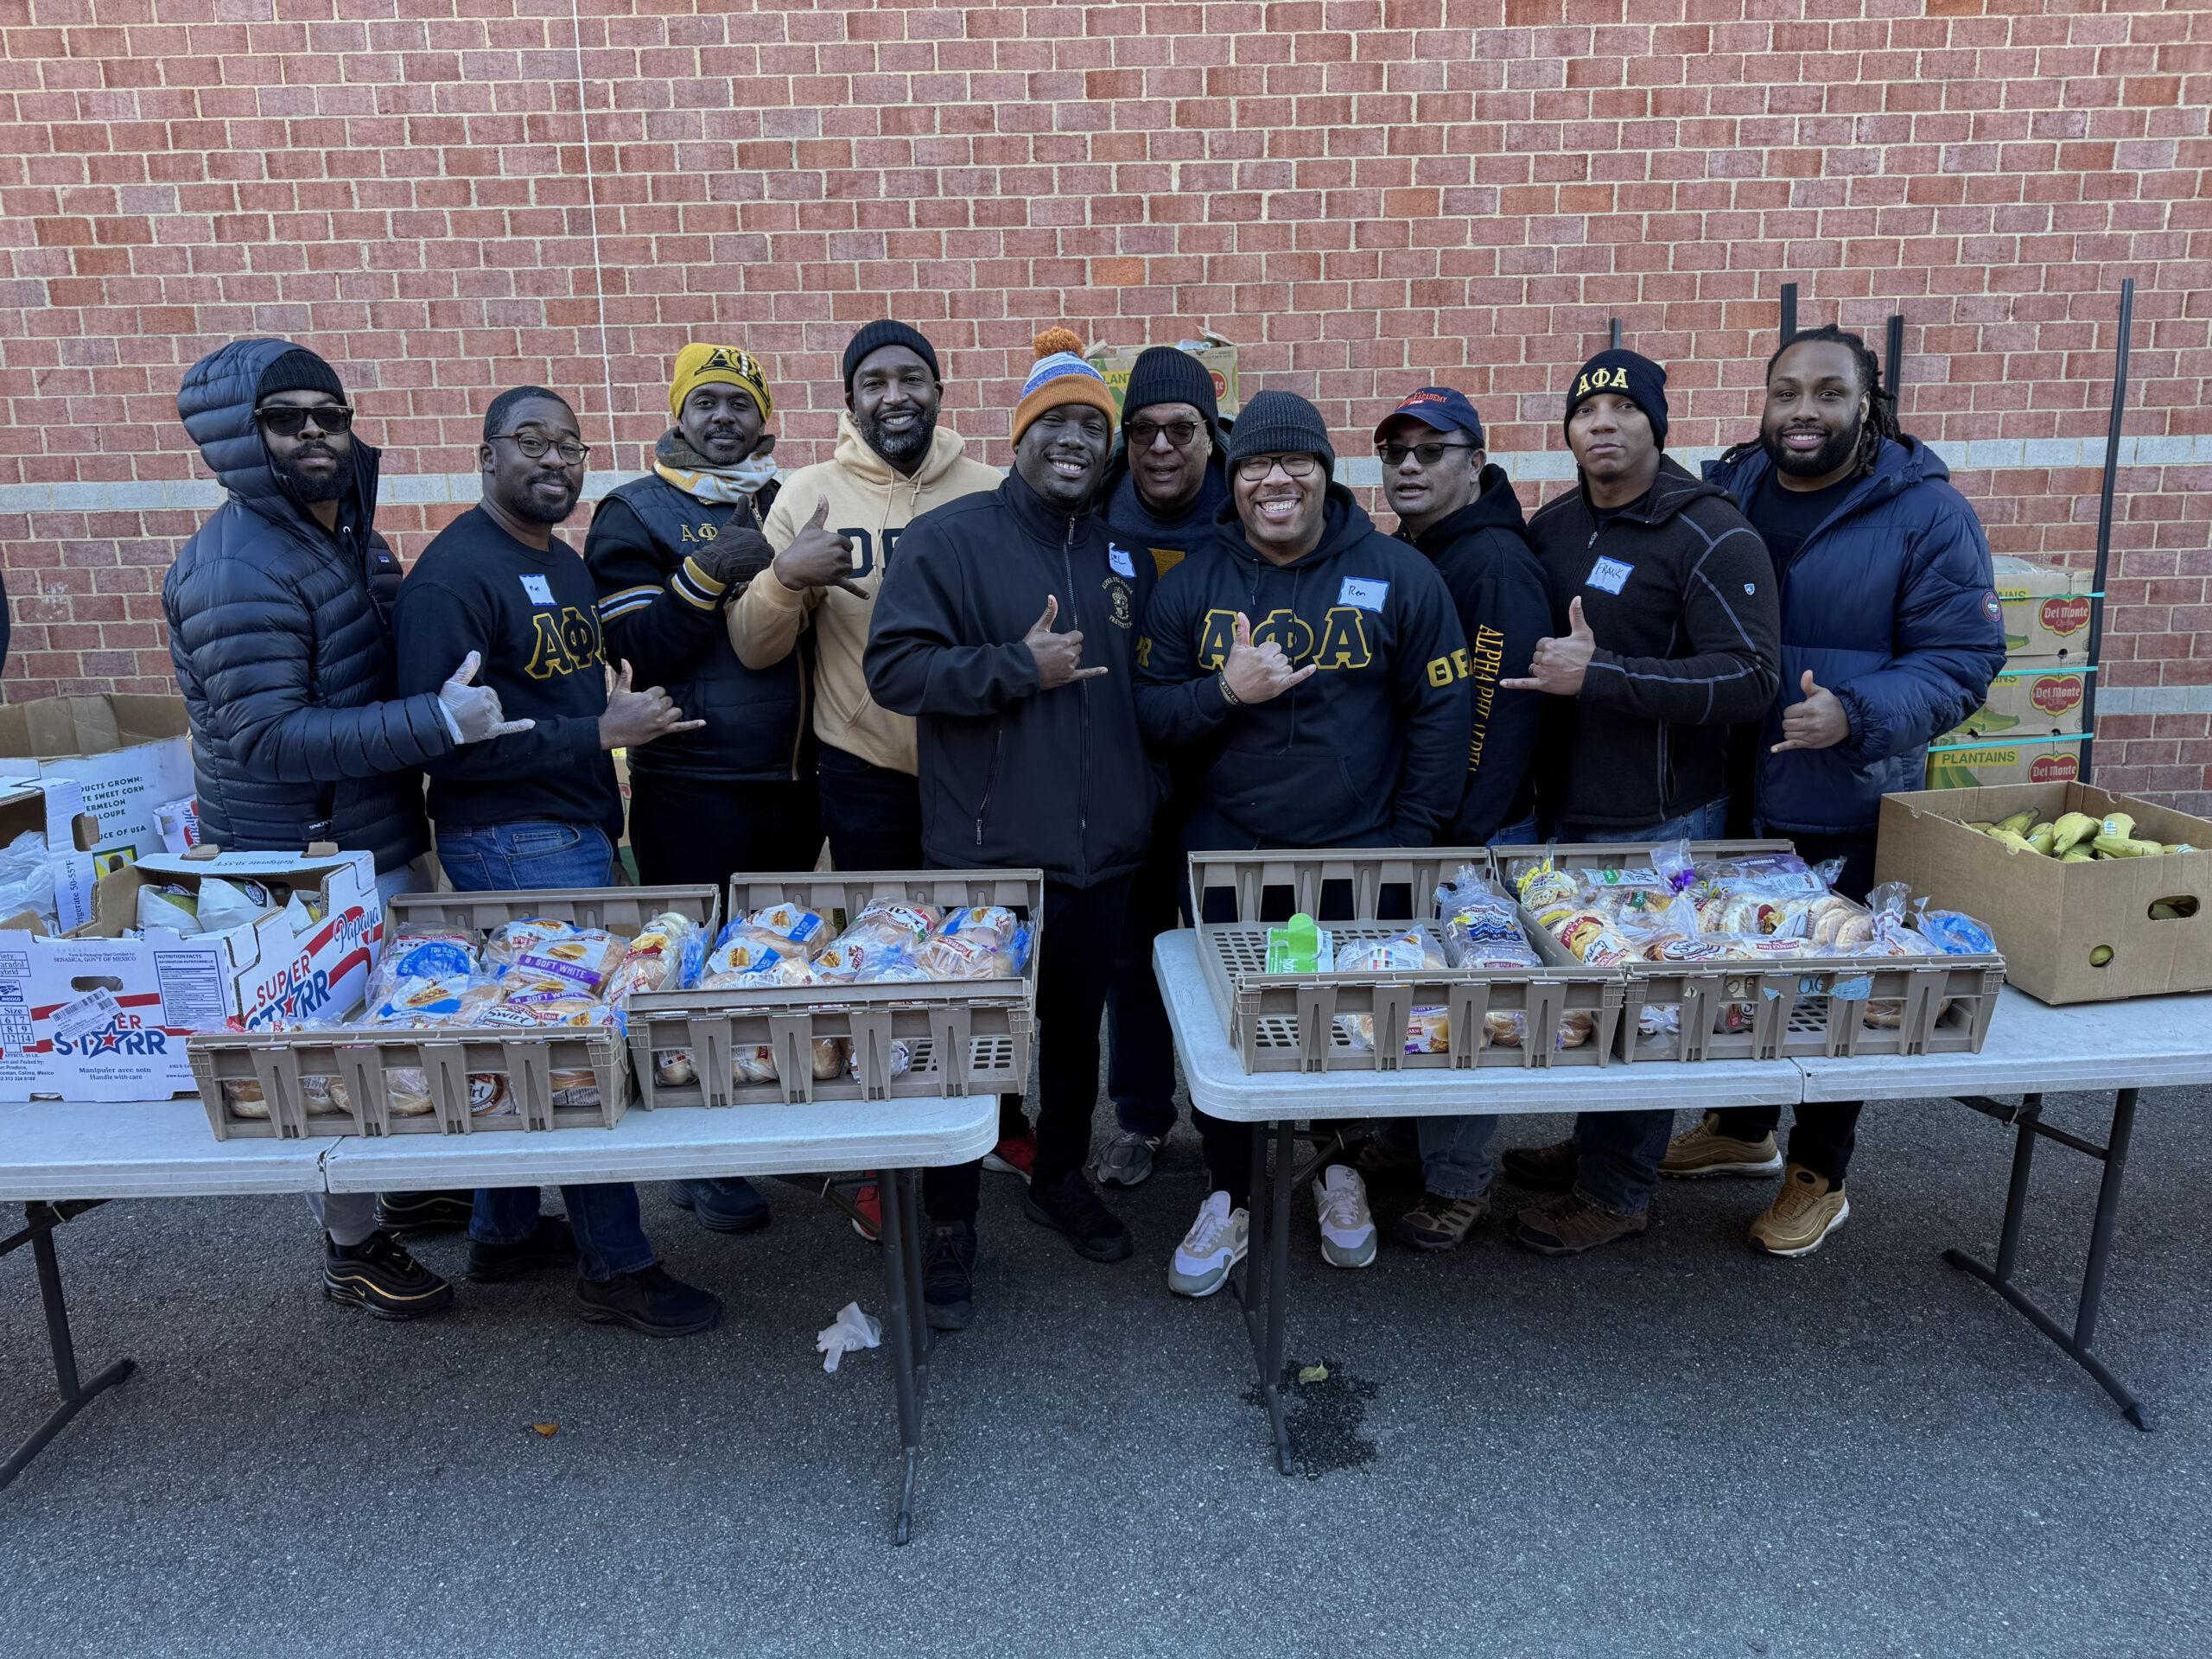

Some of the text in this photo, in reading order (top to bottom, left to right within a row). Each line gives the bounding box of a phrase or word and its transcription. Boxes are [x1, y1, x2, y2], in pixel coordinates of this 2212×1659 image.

[1576, 367, 1629, 397] ΑΦΑ
[680, 523, 721, 542] ΑΦ
[1596, 563, 1624, 579] FRANK
[2044, 607, 2088, 619] Del Monte
[1473, 624, 1504, 682] ALPHA
[2036, 686, 2081, 698] Del Monte
[1942, 752, 2016, 764] PLANTAINS
[2033, 766, 2076, 777] Del Monte
[108, 776, 143, 787] GROWN:
[94, 790, 119, 801] SWEET
[122, 785, 144, 795] CORN
[86, 799, 126, 811] ERMELON
[98, 809, 126, 820] LOUPE
[130, 825, 147, 834] USA
[334, 907, 380, 953] Papaya
[0, 968, 19, 976] ybrid
[536, 958, 556, 969] SOFT
[559, 964, 587, 978] WHITE
[257, 954, 310, 1007] SUPER
[117, 1014, 142, 1030] ER
[488, 1009, 530, 1024] Swirl
